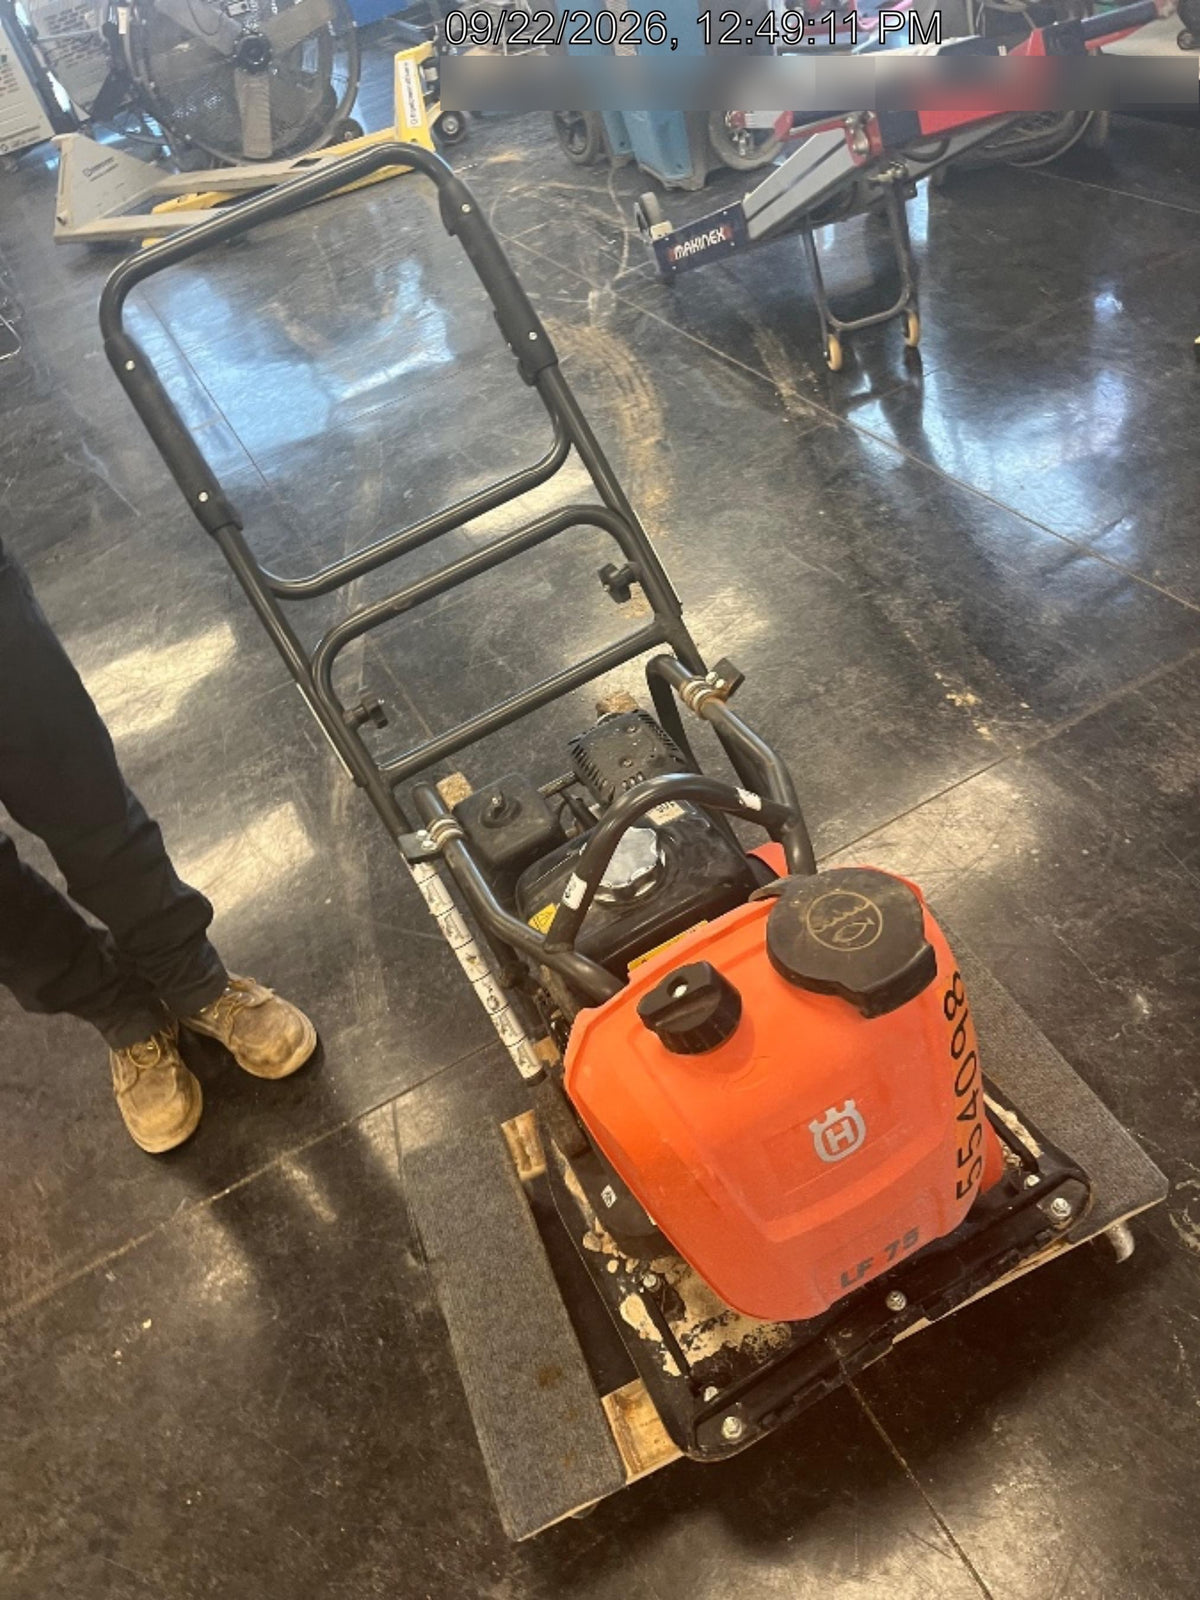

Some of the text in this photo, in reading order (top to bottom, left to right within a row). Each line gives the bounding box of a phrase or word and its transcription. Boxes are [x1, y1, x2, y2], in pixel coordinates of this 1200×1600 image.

[673, 226, 727, 260] MAKINEX
[943, 971, 982, 1201] 554098
[840, 1226, 920, 1288] LF 75
